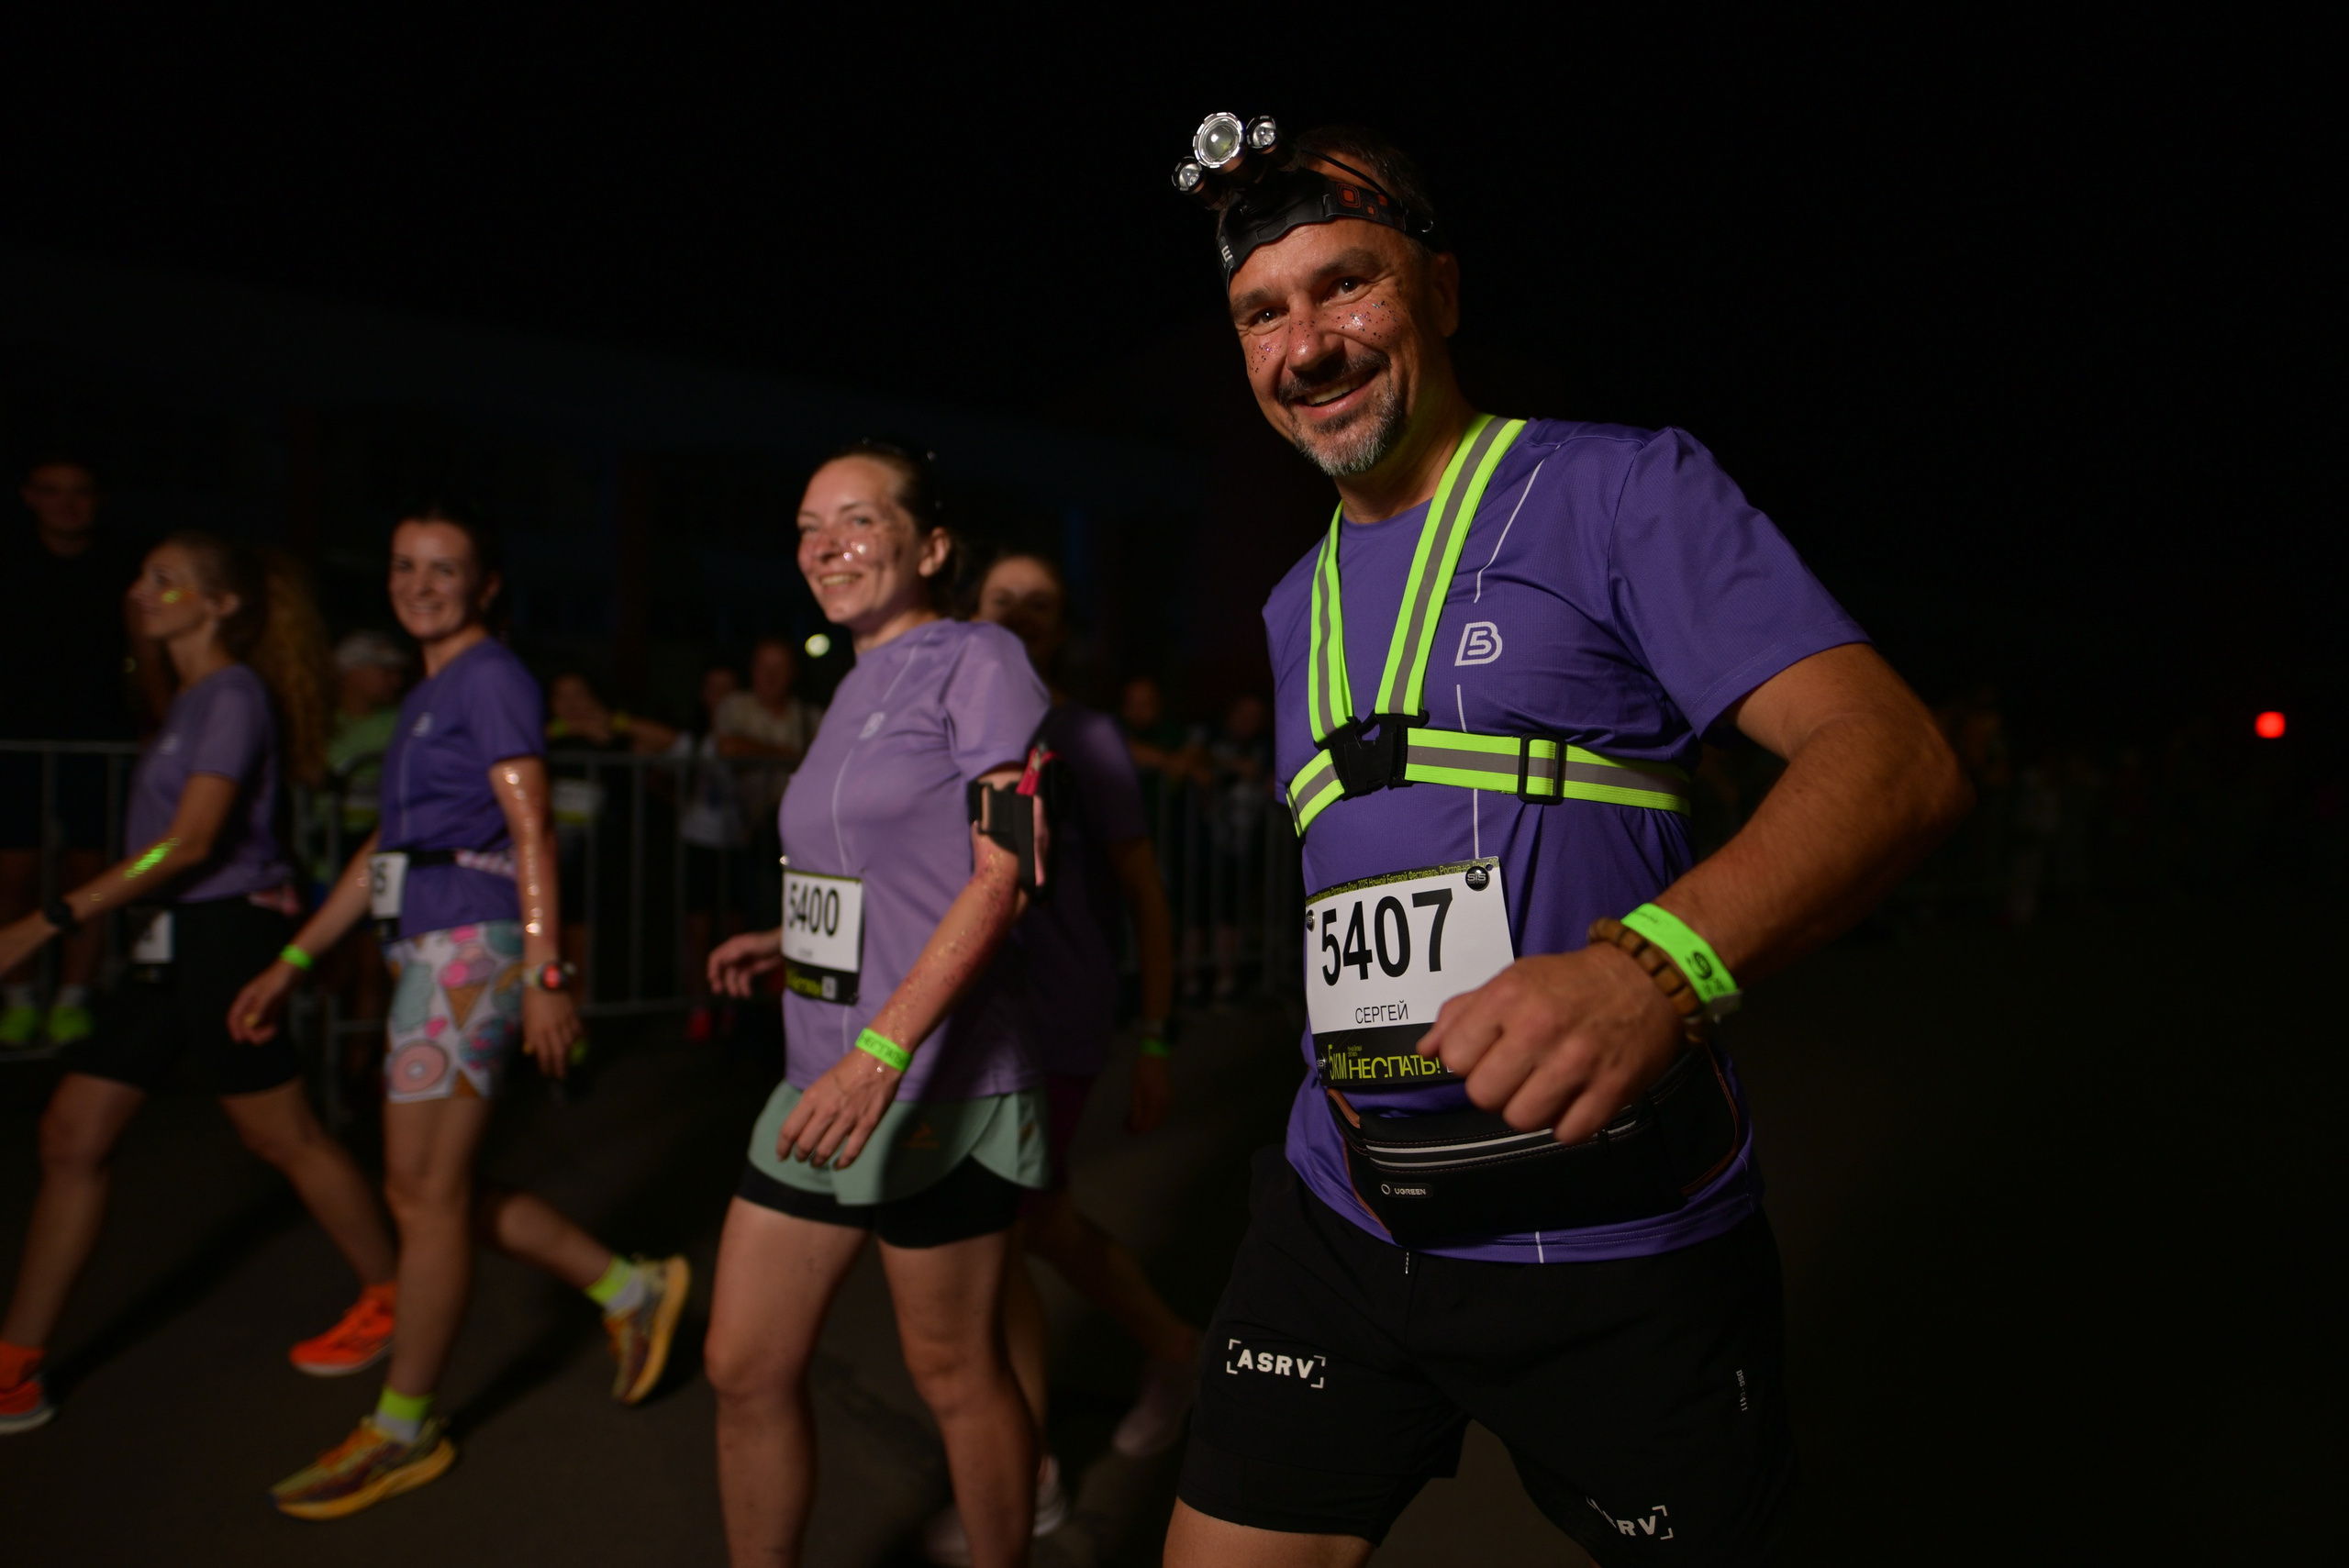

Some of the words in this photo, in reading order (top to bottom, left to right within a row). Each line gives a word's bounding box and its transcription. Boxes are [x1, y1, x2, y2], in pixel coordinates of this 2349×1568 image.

[1386, 872, 1408, 884] Беговой
[1408, 869, 1439, 881] Фестиваль
[787, 881, 841, 938] 5400
[1322, 887, 1453, 986] 5407
[1355, 999, 1408, 1024] СЕРГЕЙ
[1348, 1054, 1442, 1080] НЕСПАТЬ!
[1394, 1187, 1427, 1195] UGREEN
[1236, 1348, 1315, 1380] ASRV
